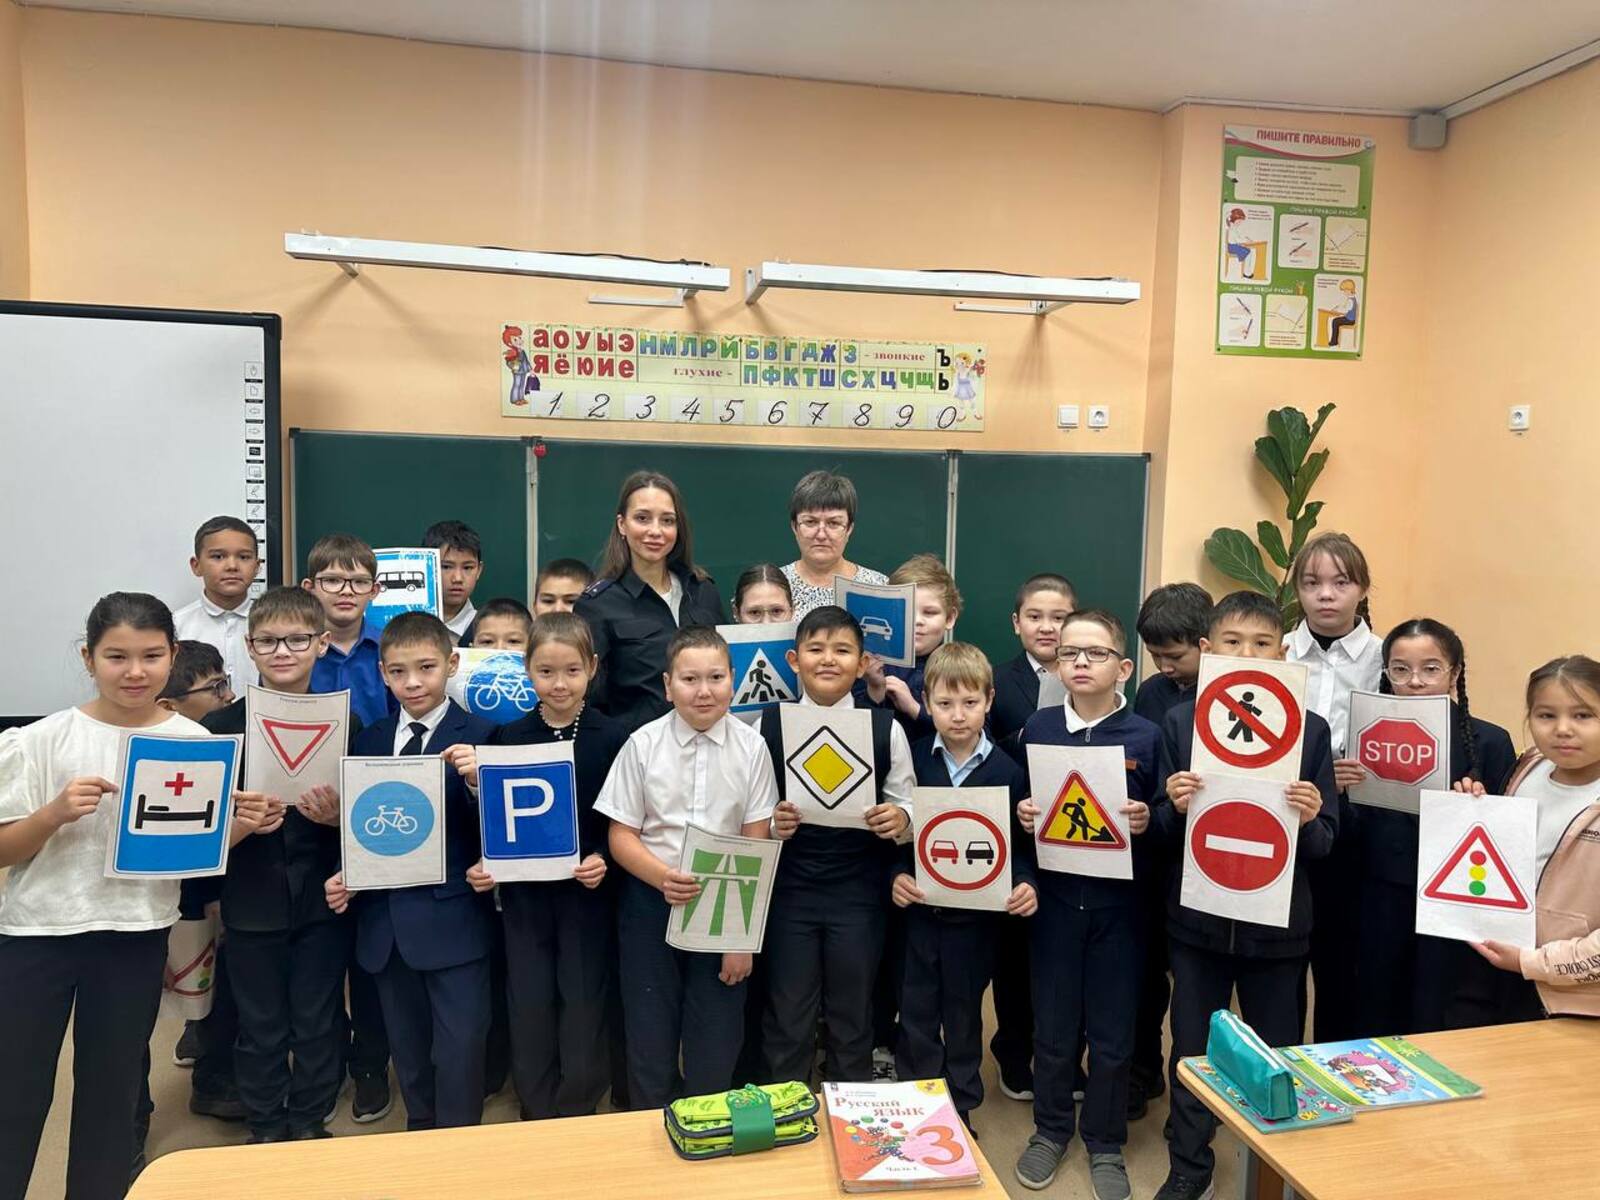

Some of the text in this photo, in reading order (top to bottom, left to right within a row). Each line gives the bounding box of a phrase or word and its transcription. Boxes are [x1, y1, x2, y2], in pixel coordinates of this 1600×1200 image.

[1257, 129, 1361, 149] ПИШИТЕ ПРАВИЛЬНО
[549, 392, 957, 429] 1 2 3 4 5 6 7 8 9 0
[1365, 742, 1433, 766] STOP
[502, 778, 555, 843] P
[834, 1097, 900, 1109] Русский
[916, 1125, 964, 1165] 3
